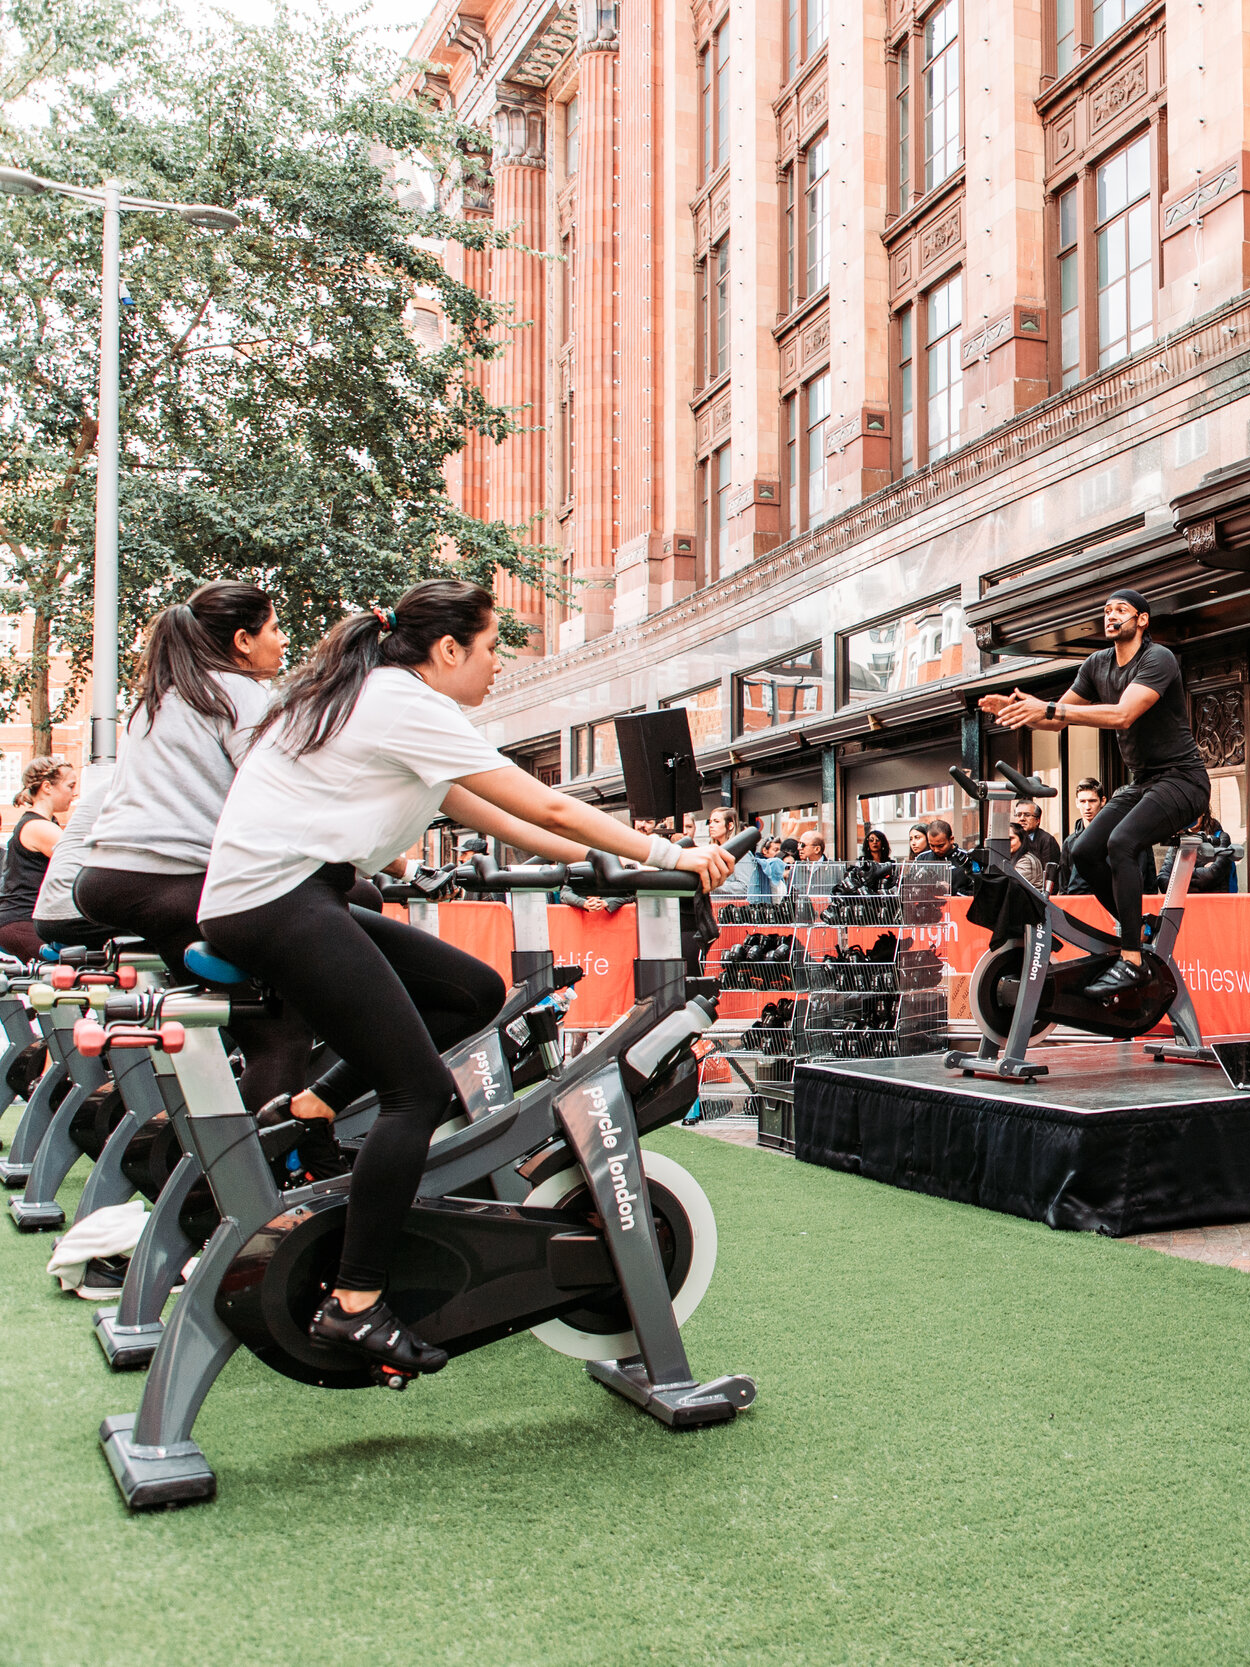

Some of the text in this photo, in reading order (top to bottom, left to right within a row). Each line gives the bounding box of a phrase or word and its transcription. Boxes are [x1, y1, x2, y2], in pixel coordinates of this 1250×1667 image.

[557, 951, 609, 976] tlife
[1029, 922, 1046, 981] cle london
[470, 1051, 501, 1101] psycle
[582, 1086, 638, 1231] psycle london
